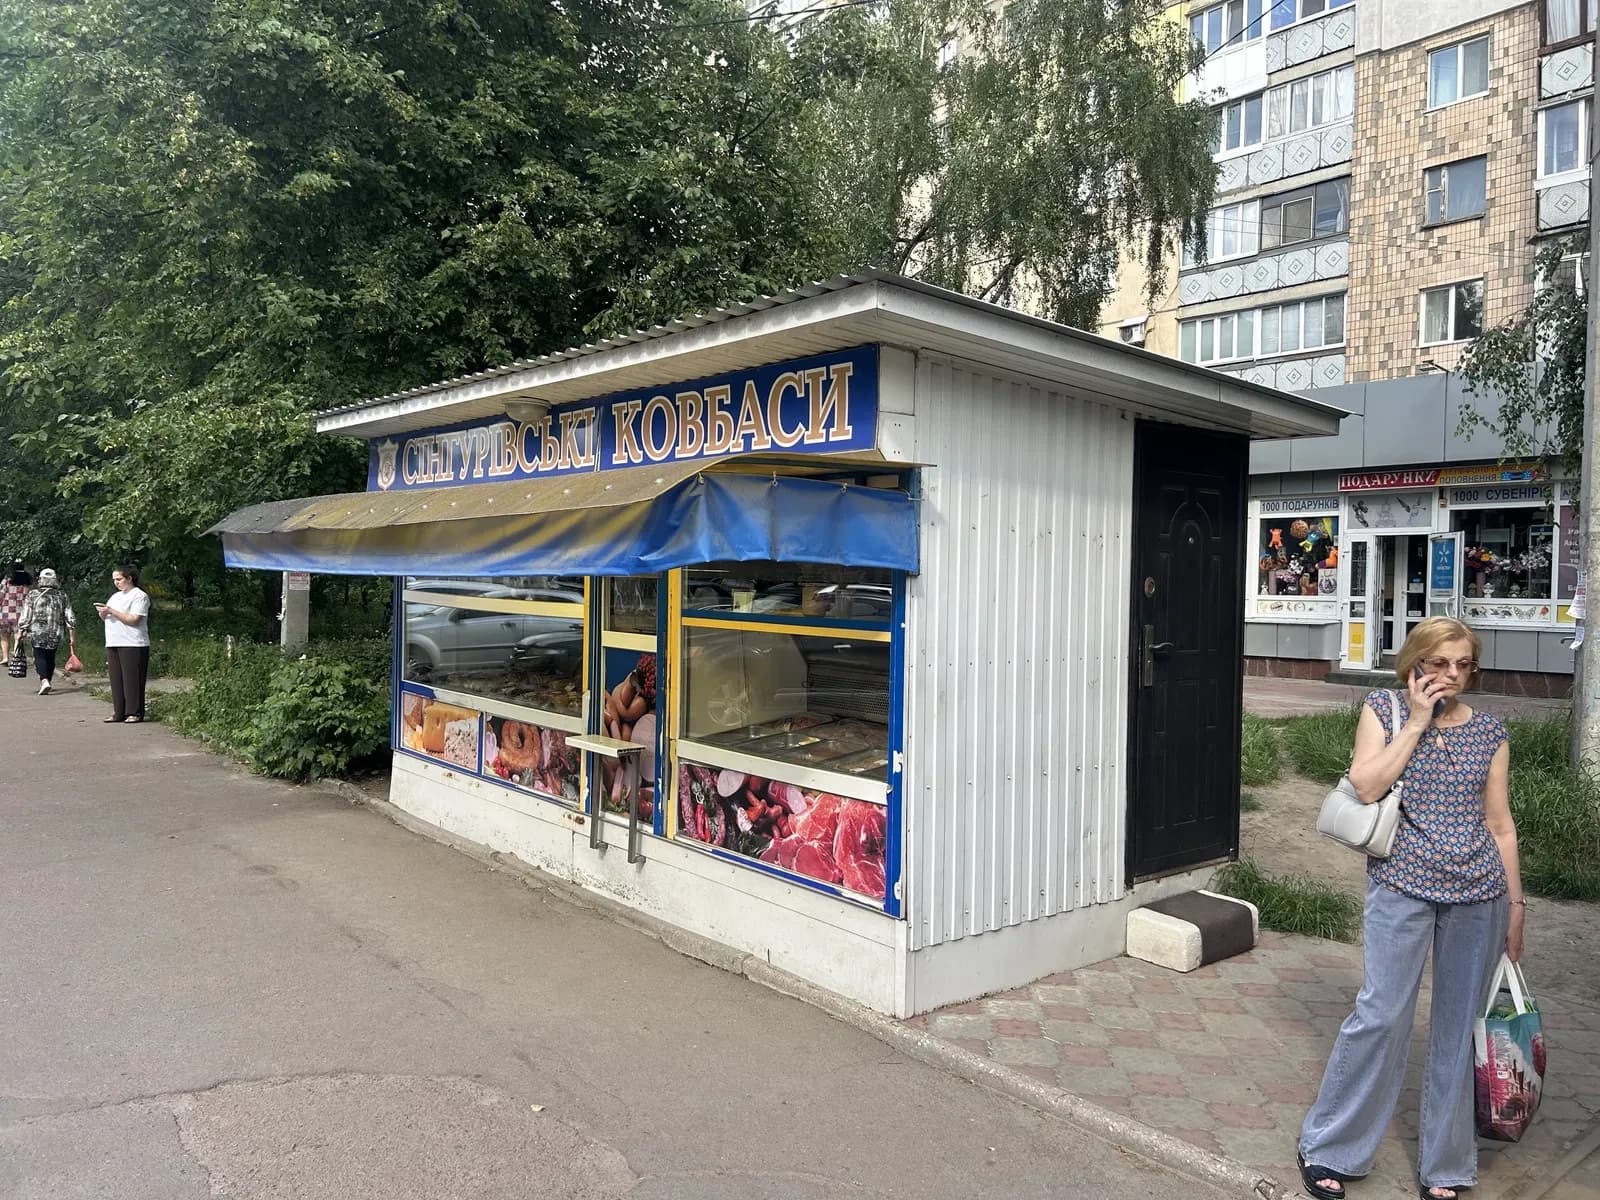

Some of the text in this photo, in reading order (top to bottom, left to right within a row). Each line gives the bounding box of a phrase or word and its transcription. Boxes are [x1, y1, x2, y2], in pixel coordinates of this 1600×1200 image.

[402, 362, 853, 486] СІНГУРІВСЬКІ КОВБАСИ
[1341, 470, 1436, 488] ПОДАРУНКИ
[1440, 473, 1497, 485] ПОПОВНЕННЯ
[1454, 490, 1479, 502] 1000
[1262, 499, 1339, 513] 1000 ПОДАРУНКІВ
